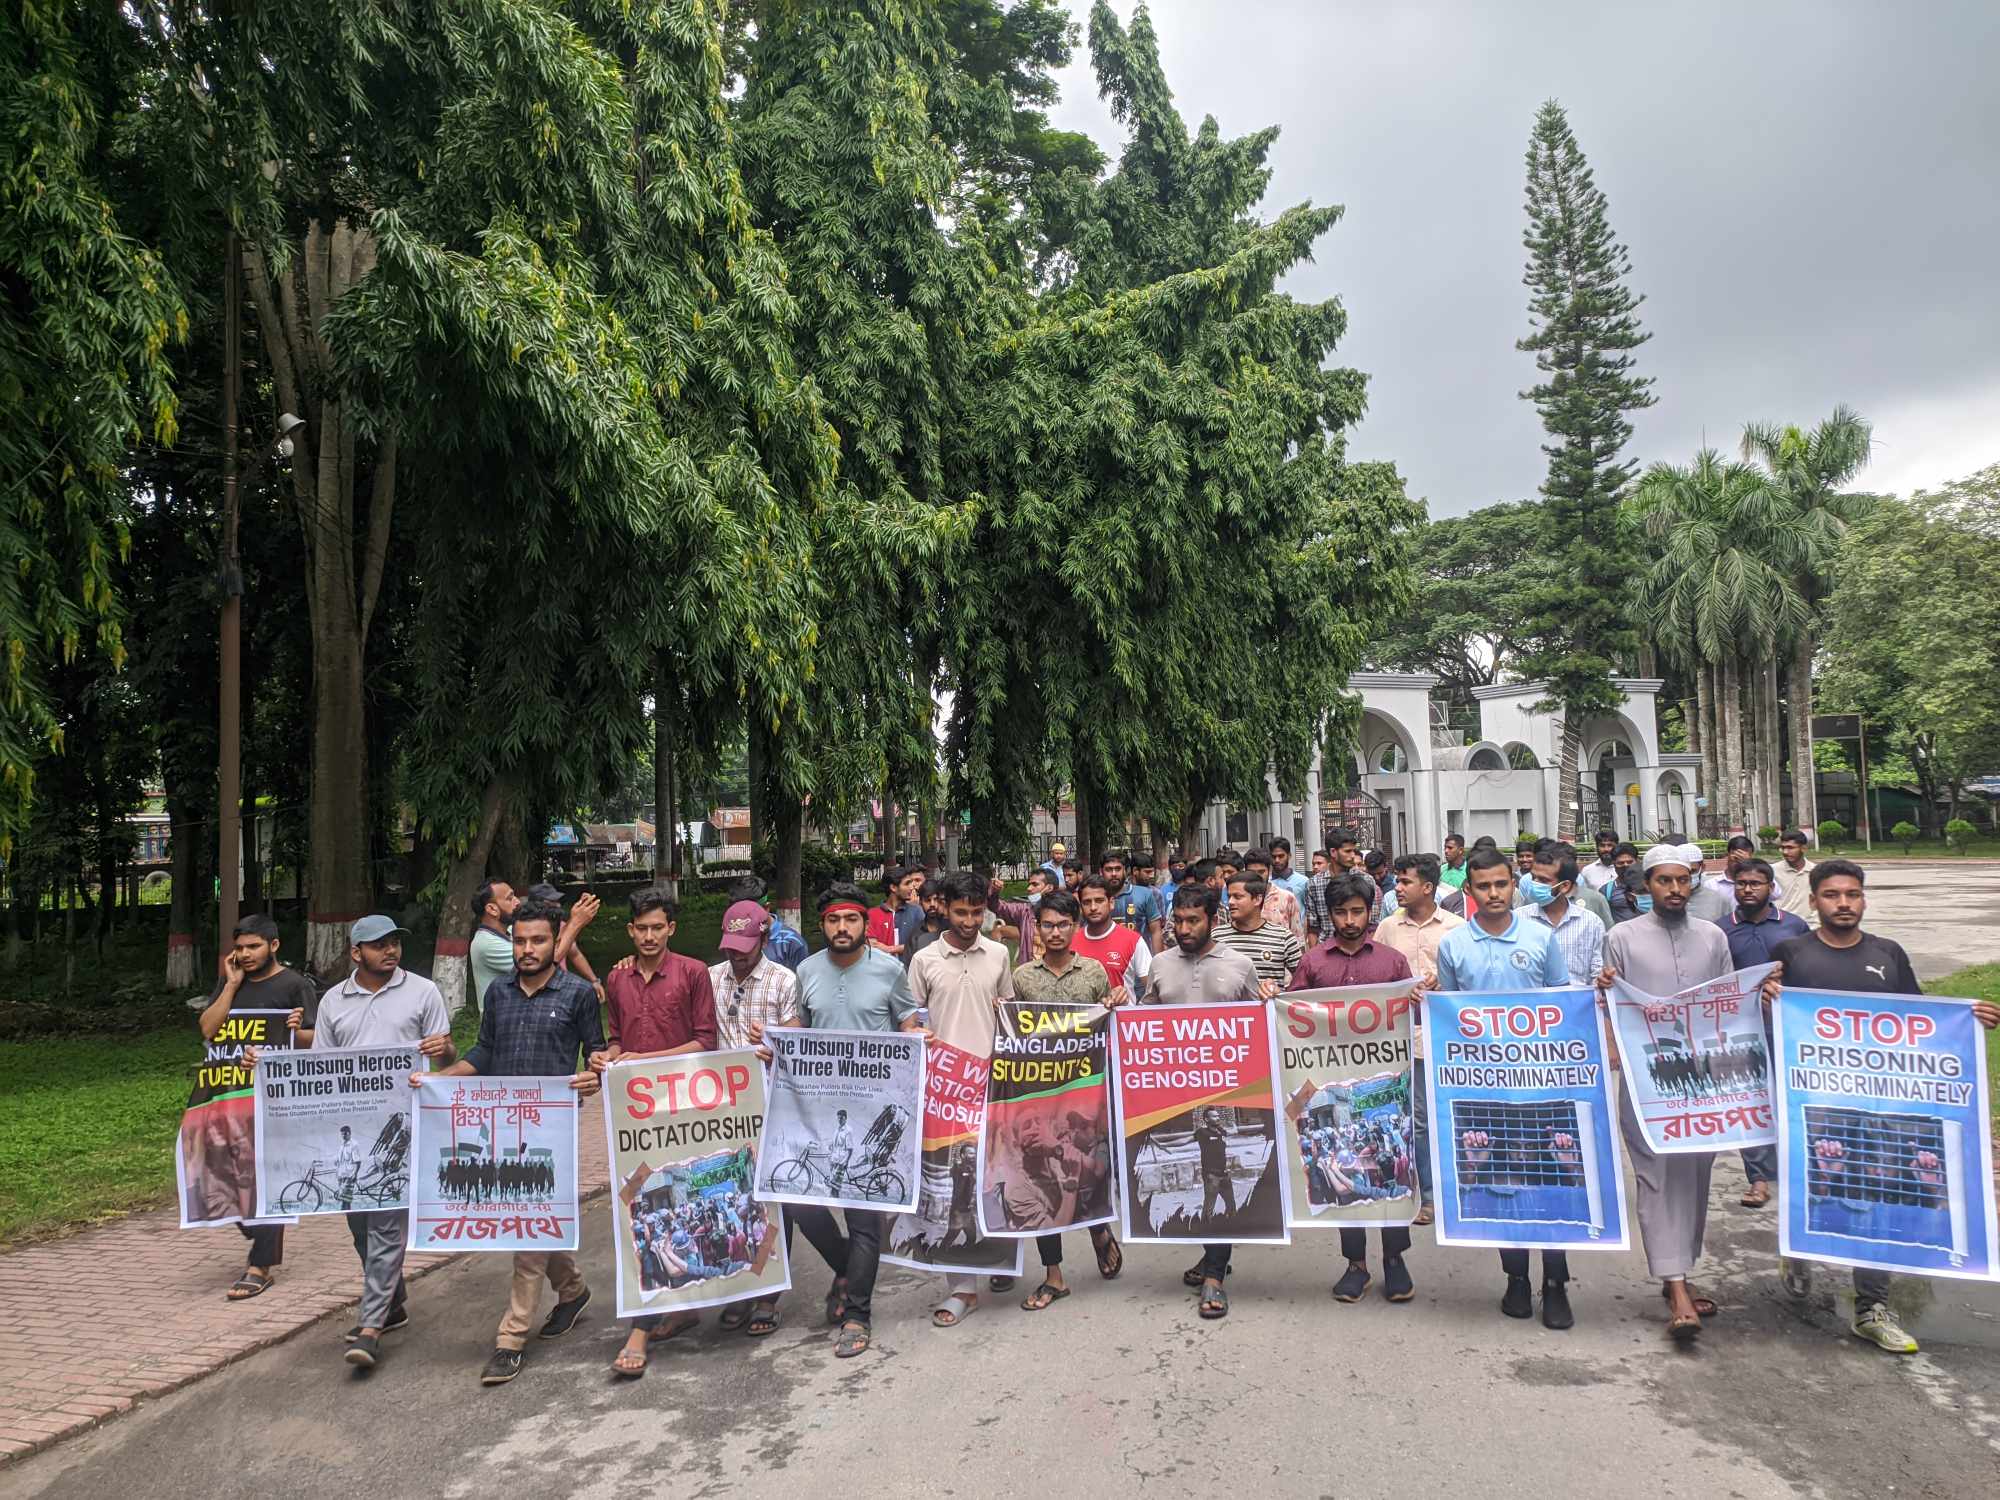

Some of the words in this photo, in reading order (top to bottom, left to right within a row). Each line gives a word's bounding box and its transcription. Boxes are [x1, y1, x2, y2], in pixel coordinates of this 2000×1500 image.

[1018, 1010, 1091, 1034] SAVE
[1120, 1020, 1165, 1042] WE
[1172, 1017, 1255, 1041] WANT
[1288, 997, 1409, 1038] STOP
[1459, 1006, 1562, 1038] STOP
[1816, 1008, 1934, 1046] STOP
[799, 1037, 855, 1059] Unsung
[859, 1040, 911, 1060] Heroes
[1123, 1046, 1214, 1066] JUSTICE
[1220, 1045, 1250, 1063] OF
[1448, 1041, 1587, 1063] PRISONING
[1800, 1044, 1960, 1077] PRISONING
[264, 1061, 292, 1079] The
[296, 1057, 354, 1076] Unsung
[358, 1054, 412, 1072] Heroes
[792, 1059, 833, 1077] Three
[838, 1060, 892, 1080] Wheels
[1125, 1069, 1240, 1089] GENOSIDE
[1439, 1065, 1597, 1088] INDISCRIMINATELY
[266, 1082, 284, 1099] on
[289, 1079, 333, 1097] Three
[338, 1075, 394, 1094] Wheels
[626, 1064, 750, 1120] STOP
[1791, 1068, 1971, 1105] INDISCRIMINATELY
[618, 1114, 763, 1153] DICTATORSHIP
[428, 1216, 564, 1242] রাজপথে
